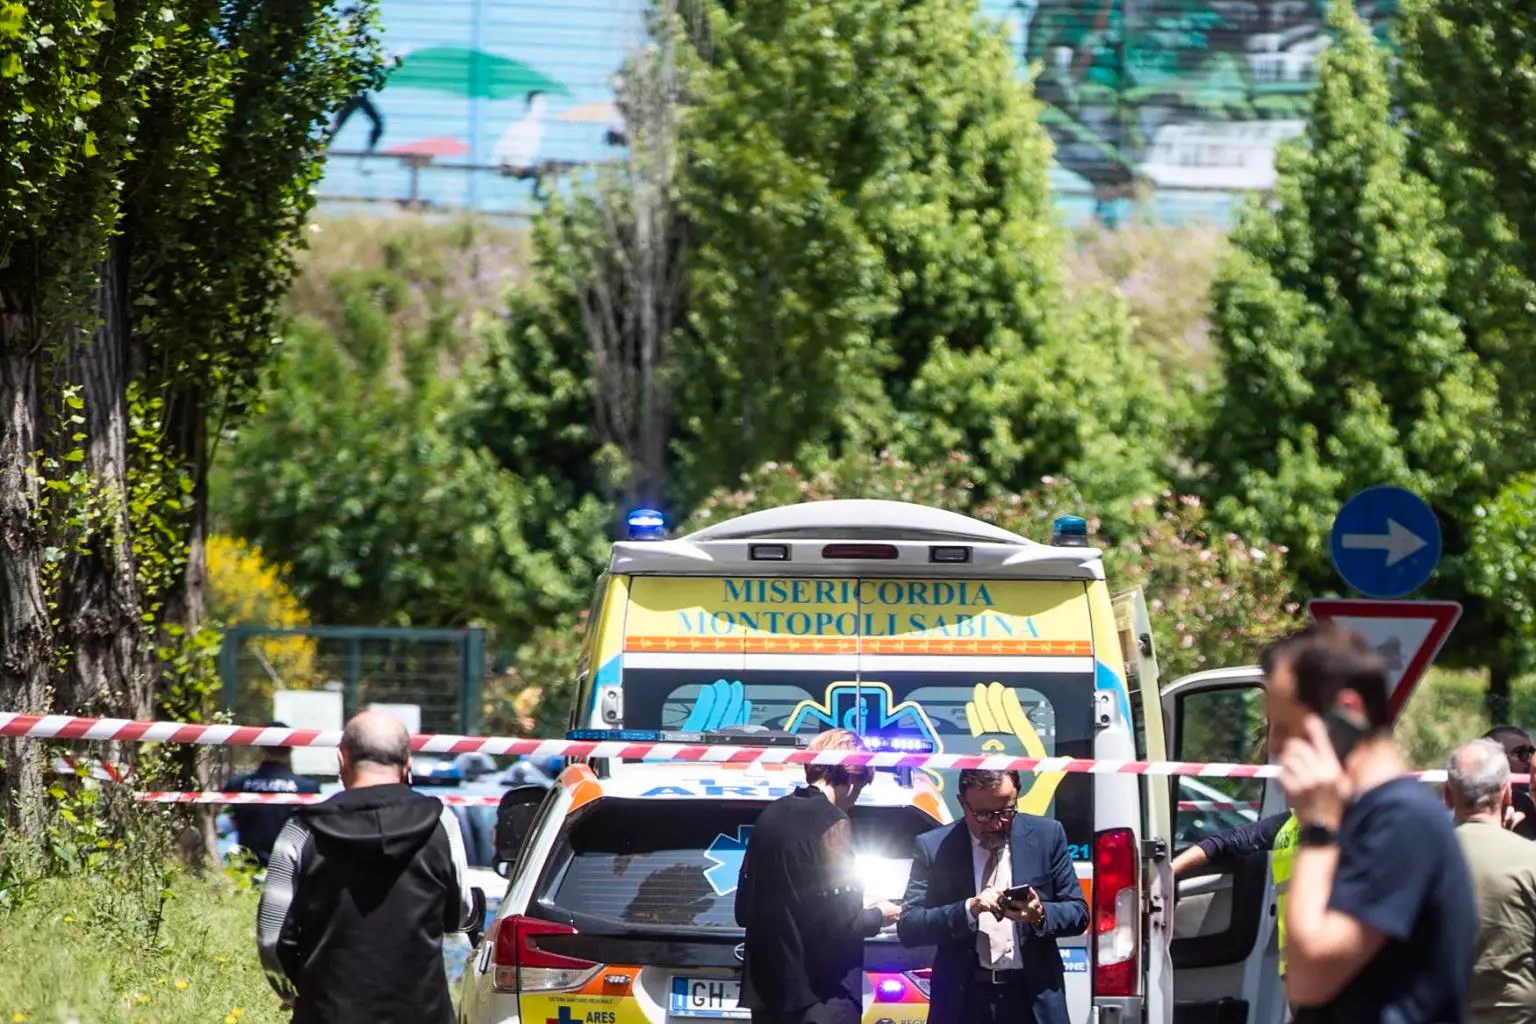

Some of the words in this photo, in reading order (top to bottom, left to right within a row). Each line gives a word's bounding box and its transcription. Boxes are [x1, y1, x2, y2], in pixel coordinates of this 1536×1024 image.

[722, 579, 996, 606] MISERICORDIA
[677, 610, 898, 637] MONTOPOLI
[909, 612, 1040, 638] SABINA
[586, 1011, 616, 1024] ARES
